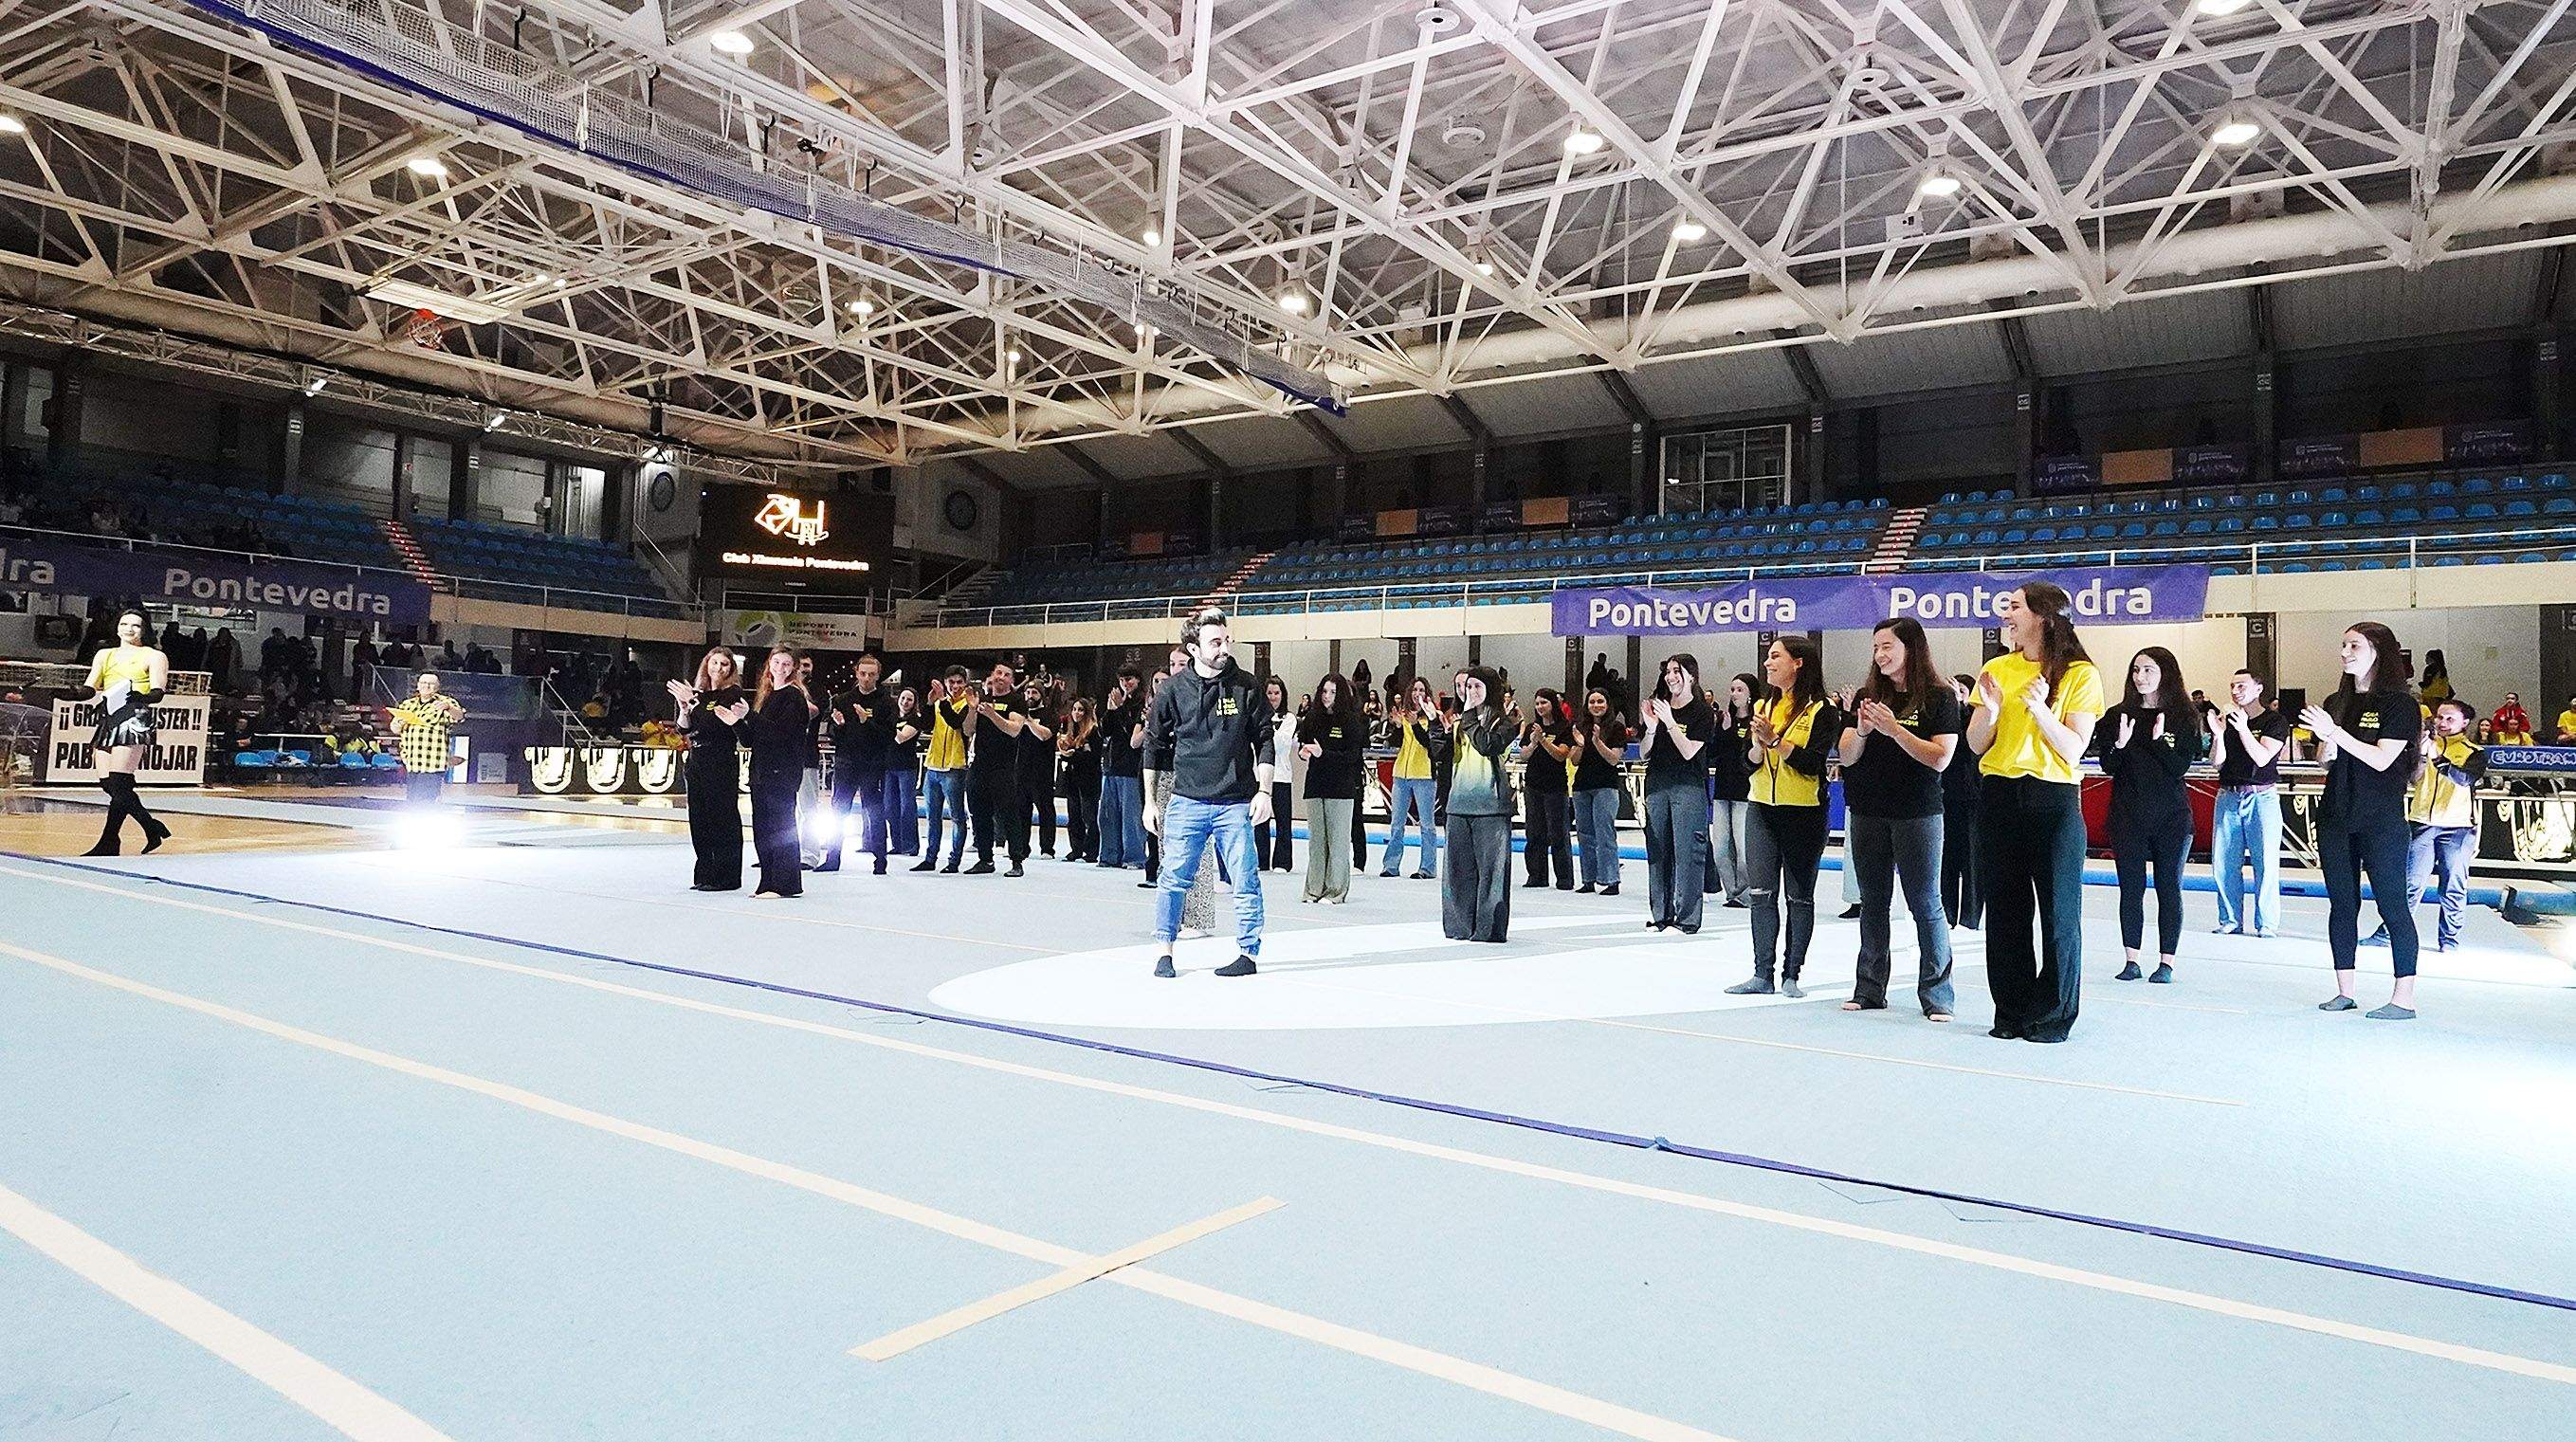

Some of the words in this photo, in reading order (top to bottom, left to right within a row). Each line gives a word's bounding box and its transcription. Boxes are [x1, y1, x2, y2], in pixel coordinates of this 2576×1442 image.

[0, 548, 55, 584] ra
[164, 568, 391, 614] Pontevedra
[1588, 589, 1797, 629] Pontevedra
[1889, 577, 2152, 619] Pontedra
[55, 742, 96, 769] PAB
[138, 744, 197, 770] NOJAR
